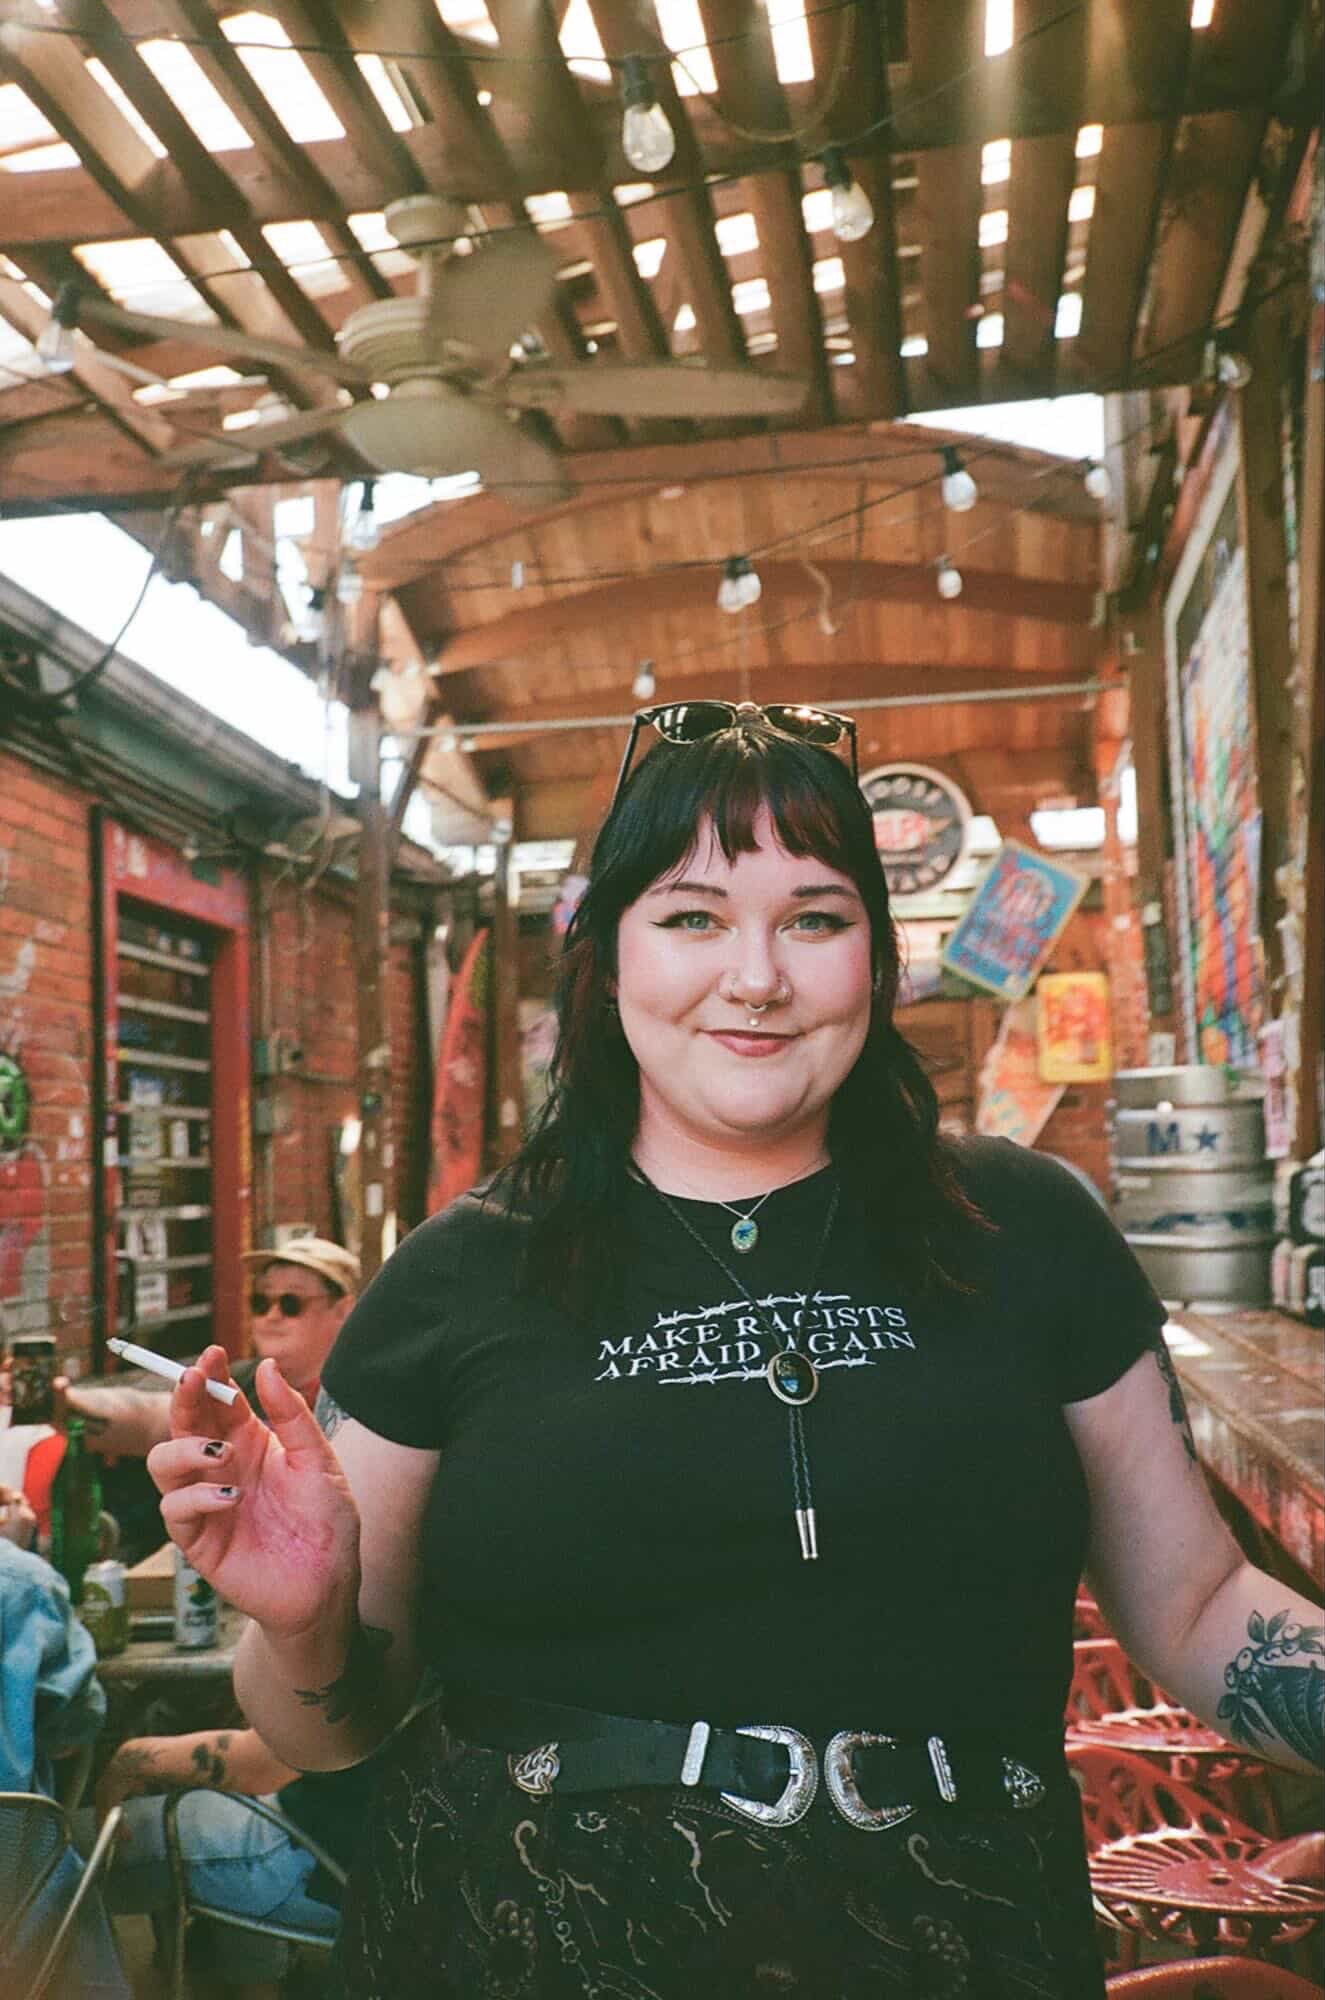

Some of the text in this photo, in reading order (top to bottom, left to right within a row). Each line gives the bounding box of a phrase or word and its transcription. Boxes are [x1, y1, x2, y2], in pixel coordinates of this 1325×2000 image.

[594, 1331, 916, 1381] AFRAID AGAIN
[598, 1306, 908, 1361] MAKE RACISTS
